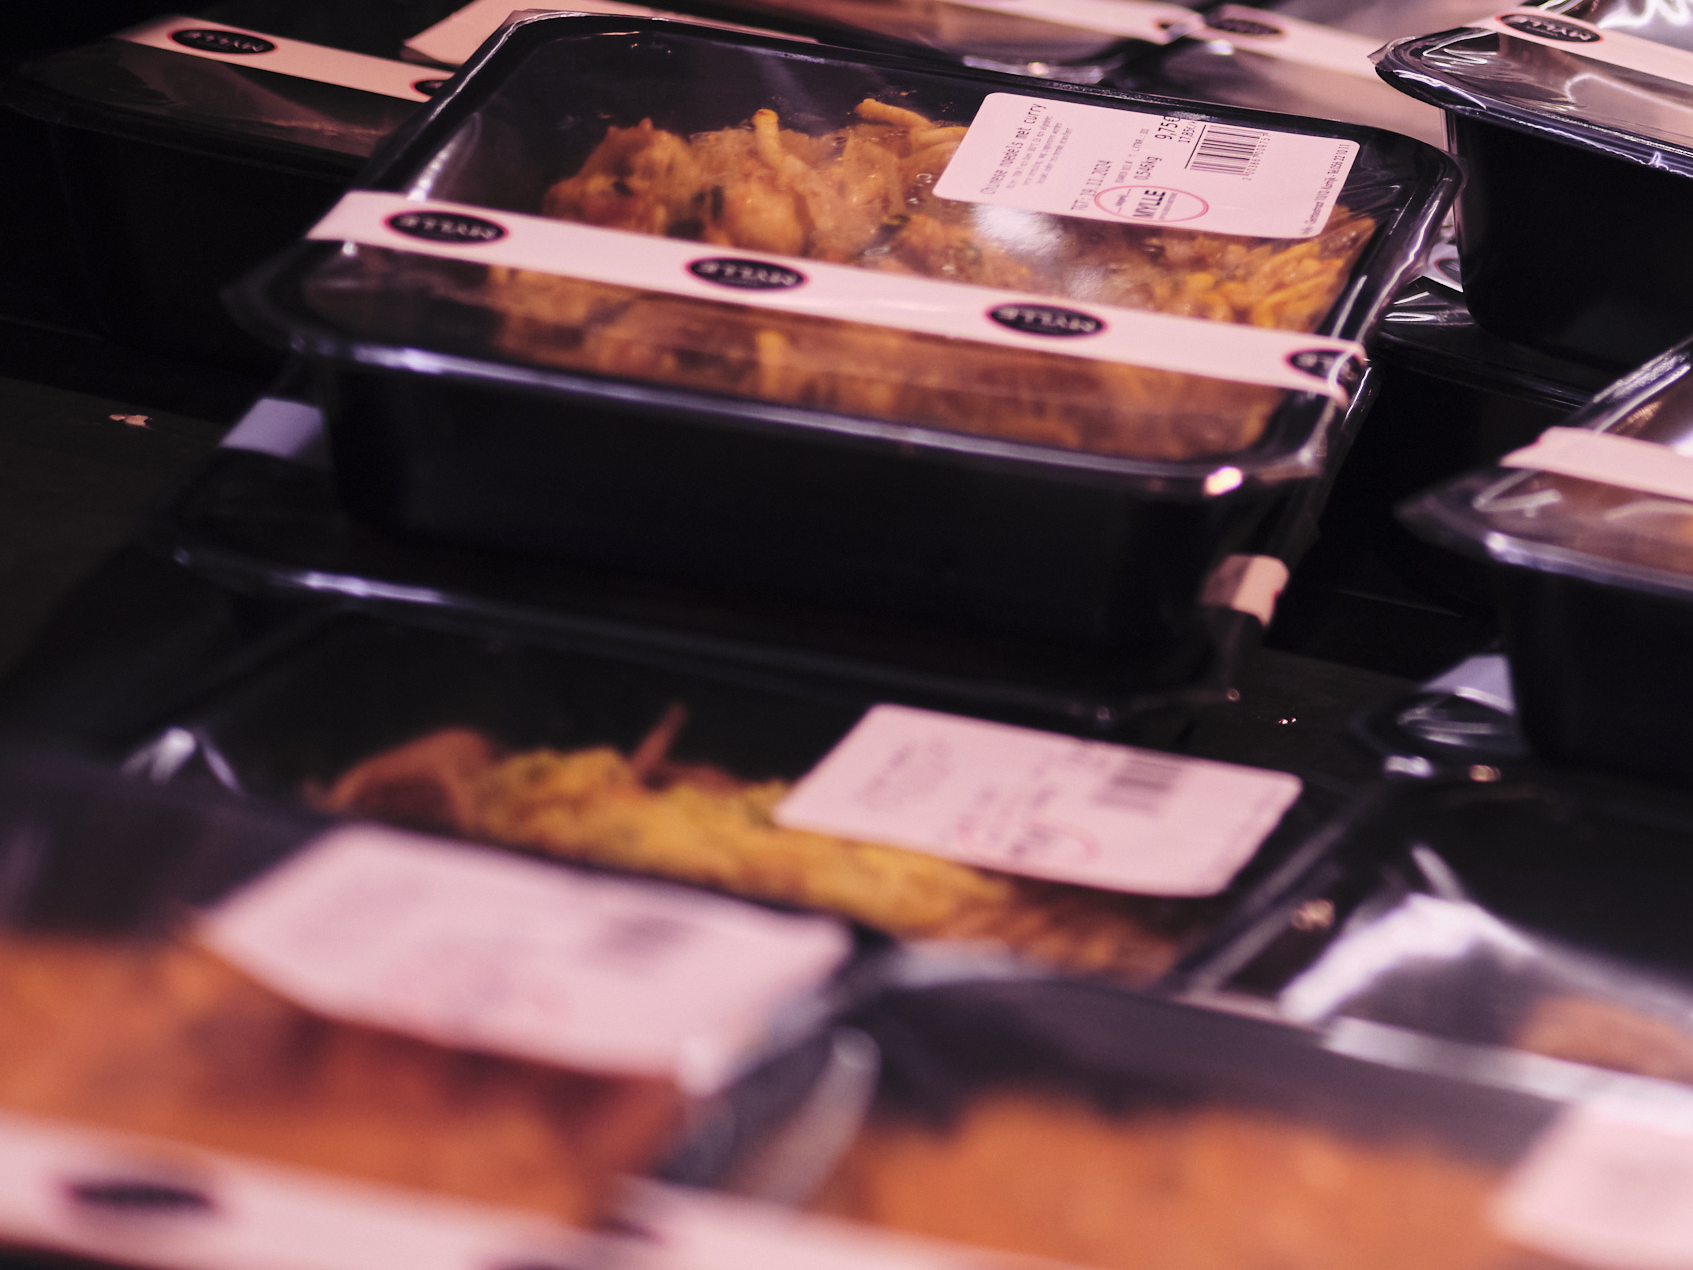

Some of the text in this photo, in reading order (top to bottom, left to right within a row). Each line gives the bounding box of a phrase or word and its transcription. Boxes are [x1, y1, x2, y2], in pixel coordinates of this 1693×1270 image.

[1509, 15, 1592, 41] MYLLE
[1015, 127, 1032, 140] met
[1024, 103, 1047, 124] curry
[1132, 189, 1166, 219] MYLLE
